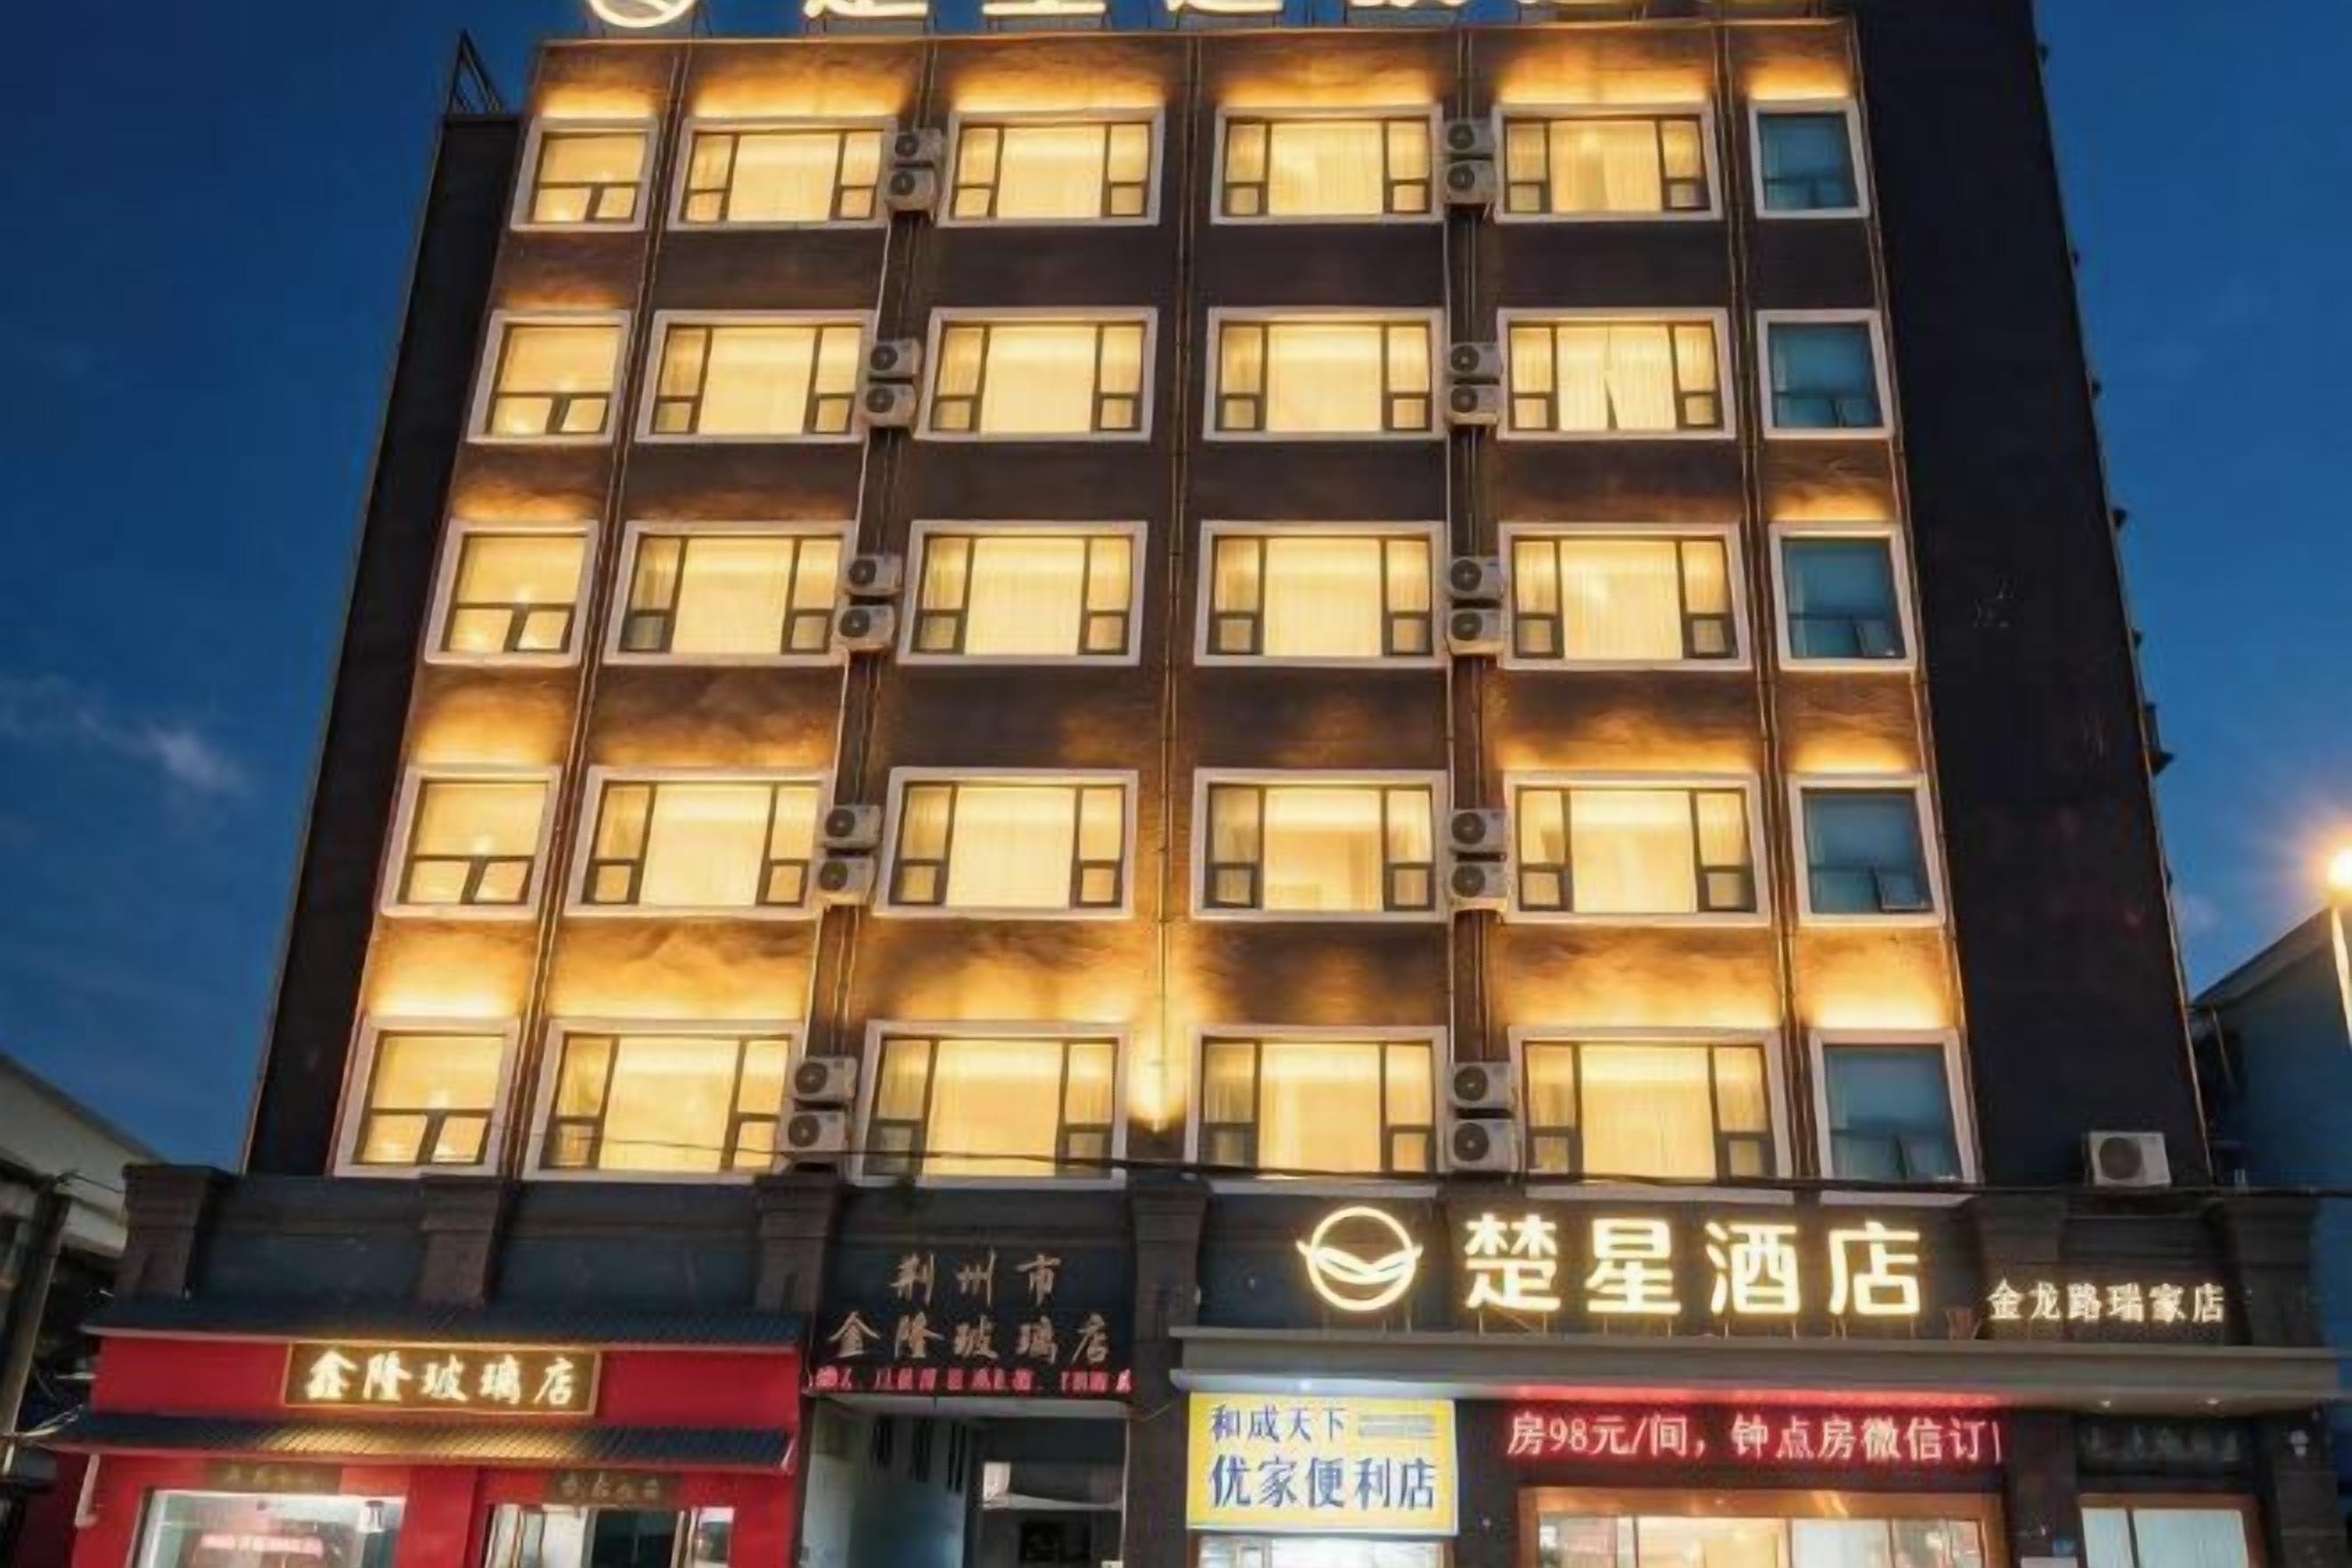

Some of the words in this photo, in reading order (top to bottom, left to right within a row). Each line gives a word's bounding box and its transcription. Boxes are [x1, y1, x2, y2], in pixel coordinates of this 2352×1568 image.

[890, 1247, 1062, 1306] 荆州市
[1463, 1212, 1922, 1316] 楚星酒店
[1212, 1403, 1346, 1443] 和成天下
[1507, 1411, 2002, 1463] 房98元/间，钟点房微信订
[1211, 1454, 1437, 1510] 优家便利店
